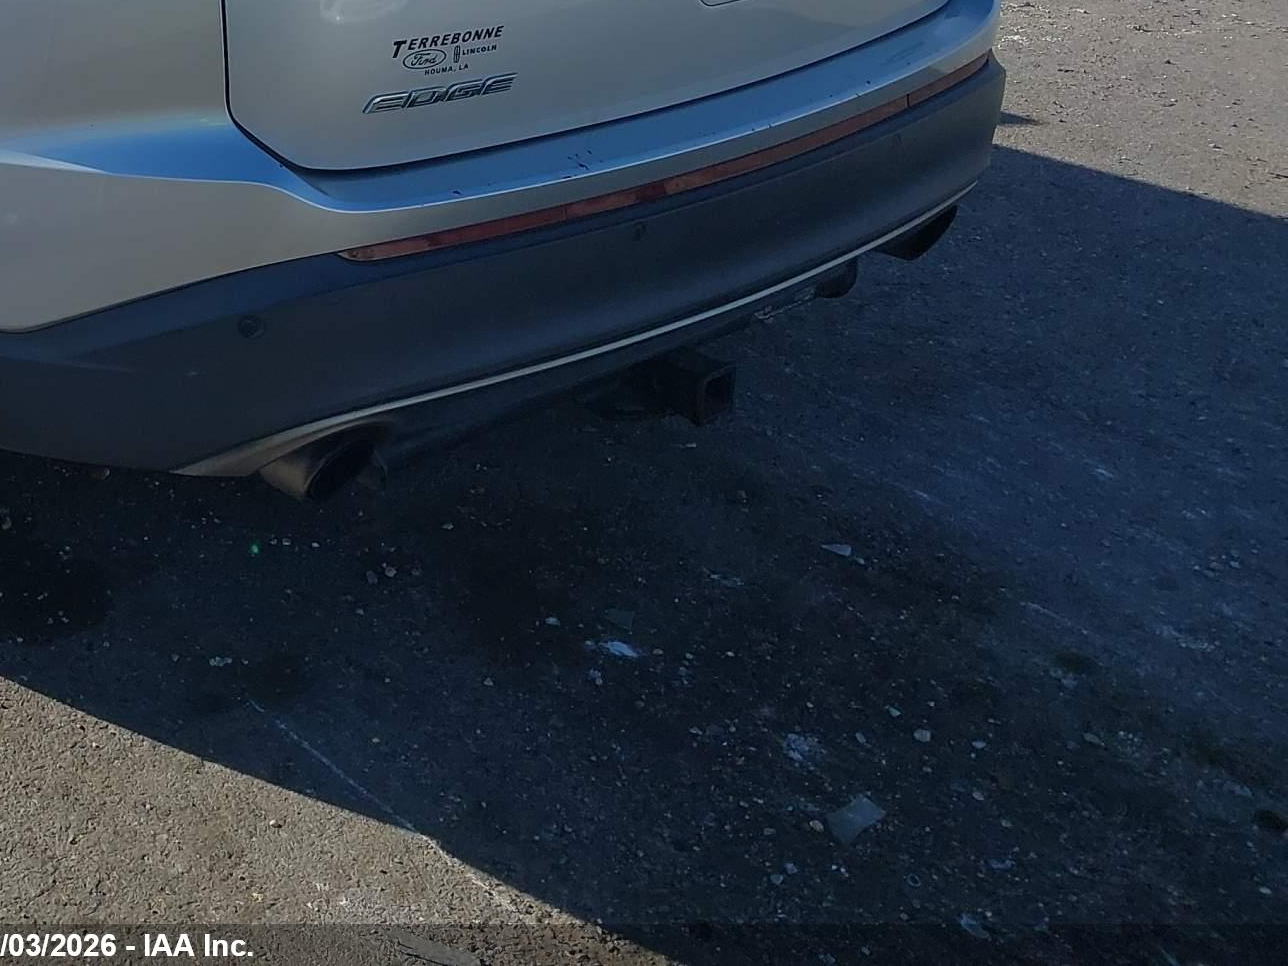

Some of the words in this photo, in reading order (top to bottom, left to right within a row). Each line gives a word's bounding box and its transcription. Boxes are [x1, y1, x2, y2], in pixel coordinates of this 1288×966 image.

[392, 25, 505, 59] TERREBONNE
[462, 44, 498, 56] LINCOLN
[424, 66, 457, 76] HOUMA,
[459, 63, 469, 71] LA
[362, 72, 518, 114] EDGE
